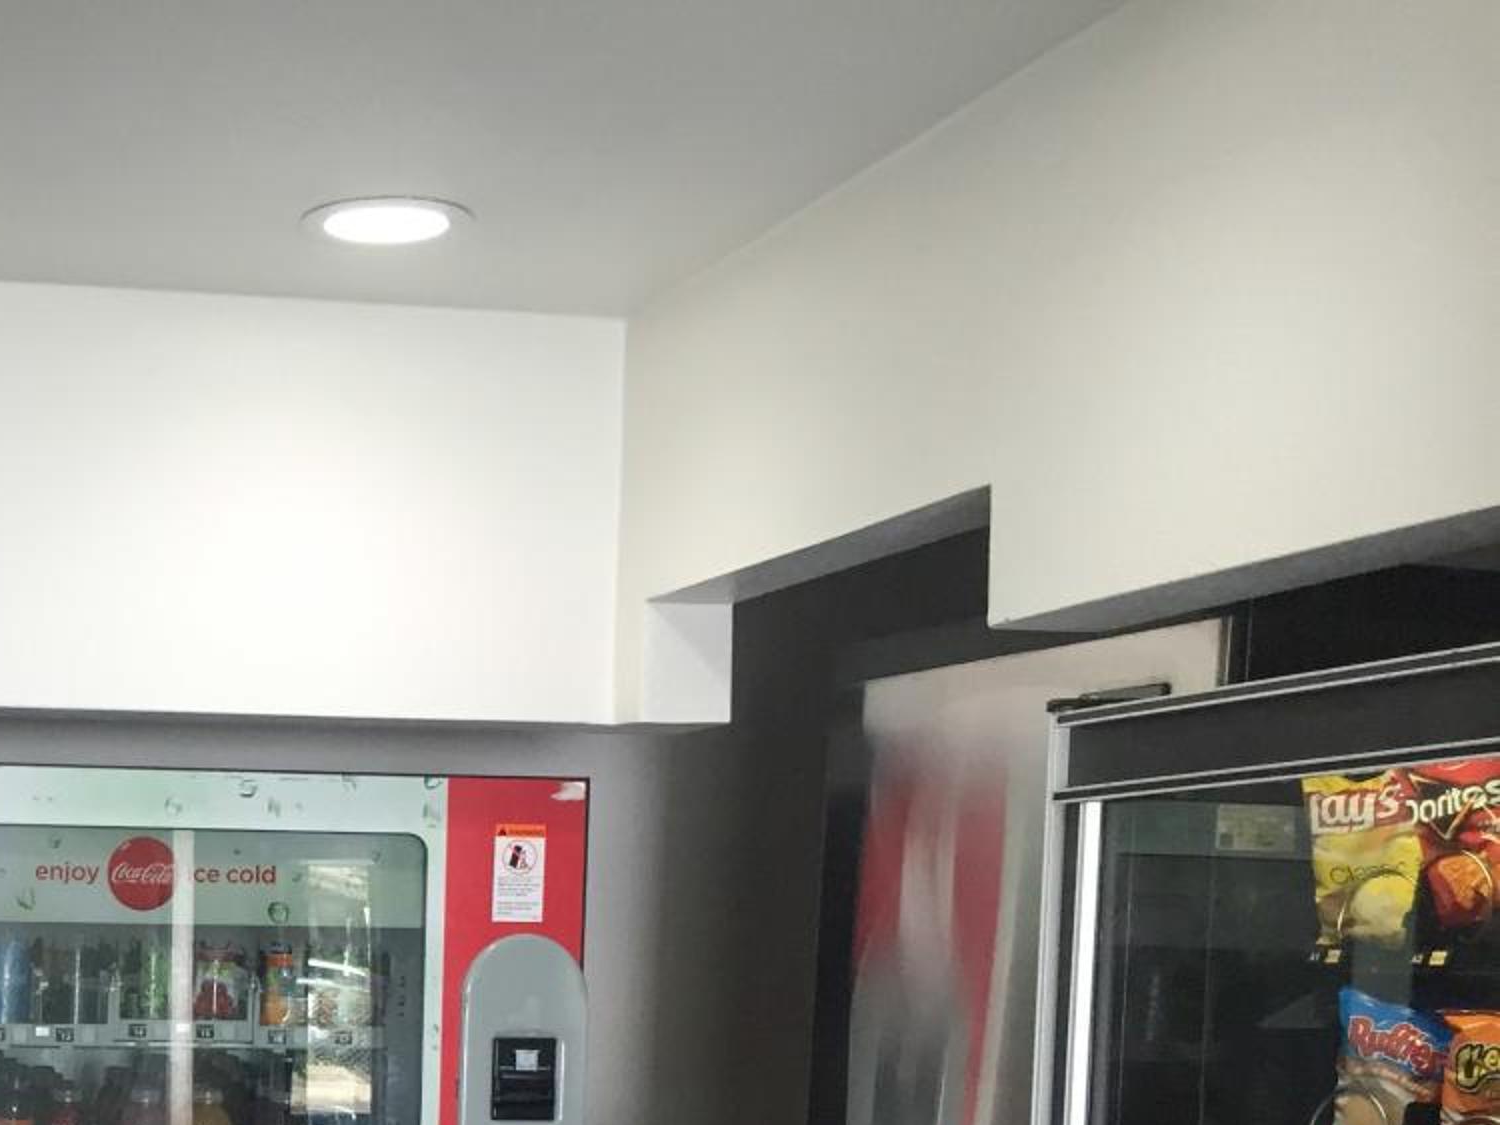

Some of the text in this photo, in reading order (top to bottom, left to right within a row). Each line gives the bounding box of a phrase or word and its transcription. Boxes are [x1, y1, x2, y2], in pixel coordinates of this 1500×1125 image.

[35, 861, 100, 884] enjoy
[192, 865, 221, 884] ce
[226, 864, 277, 884] cold
